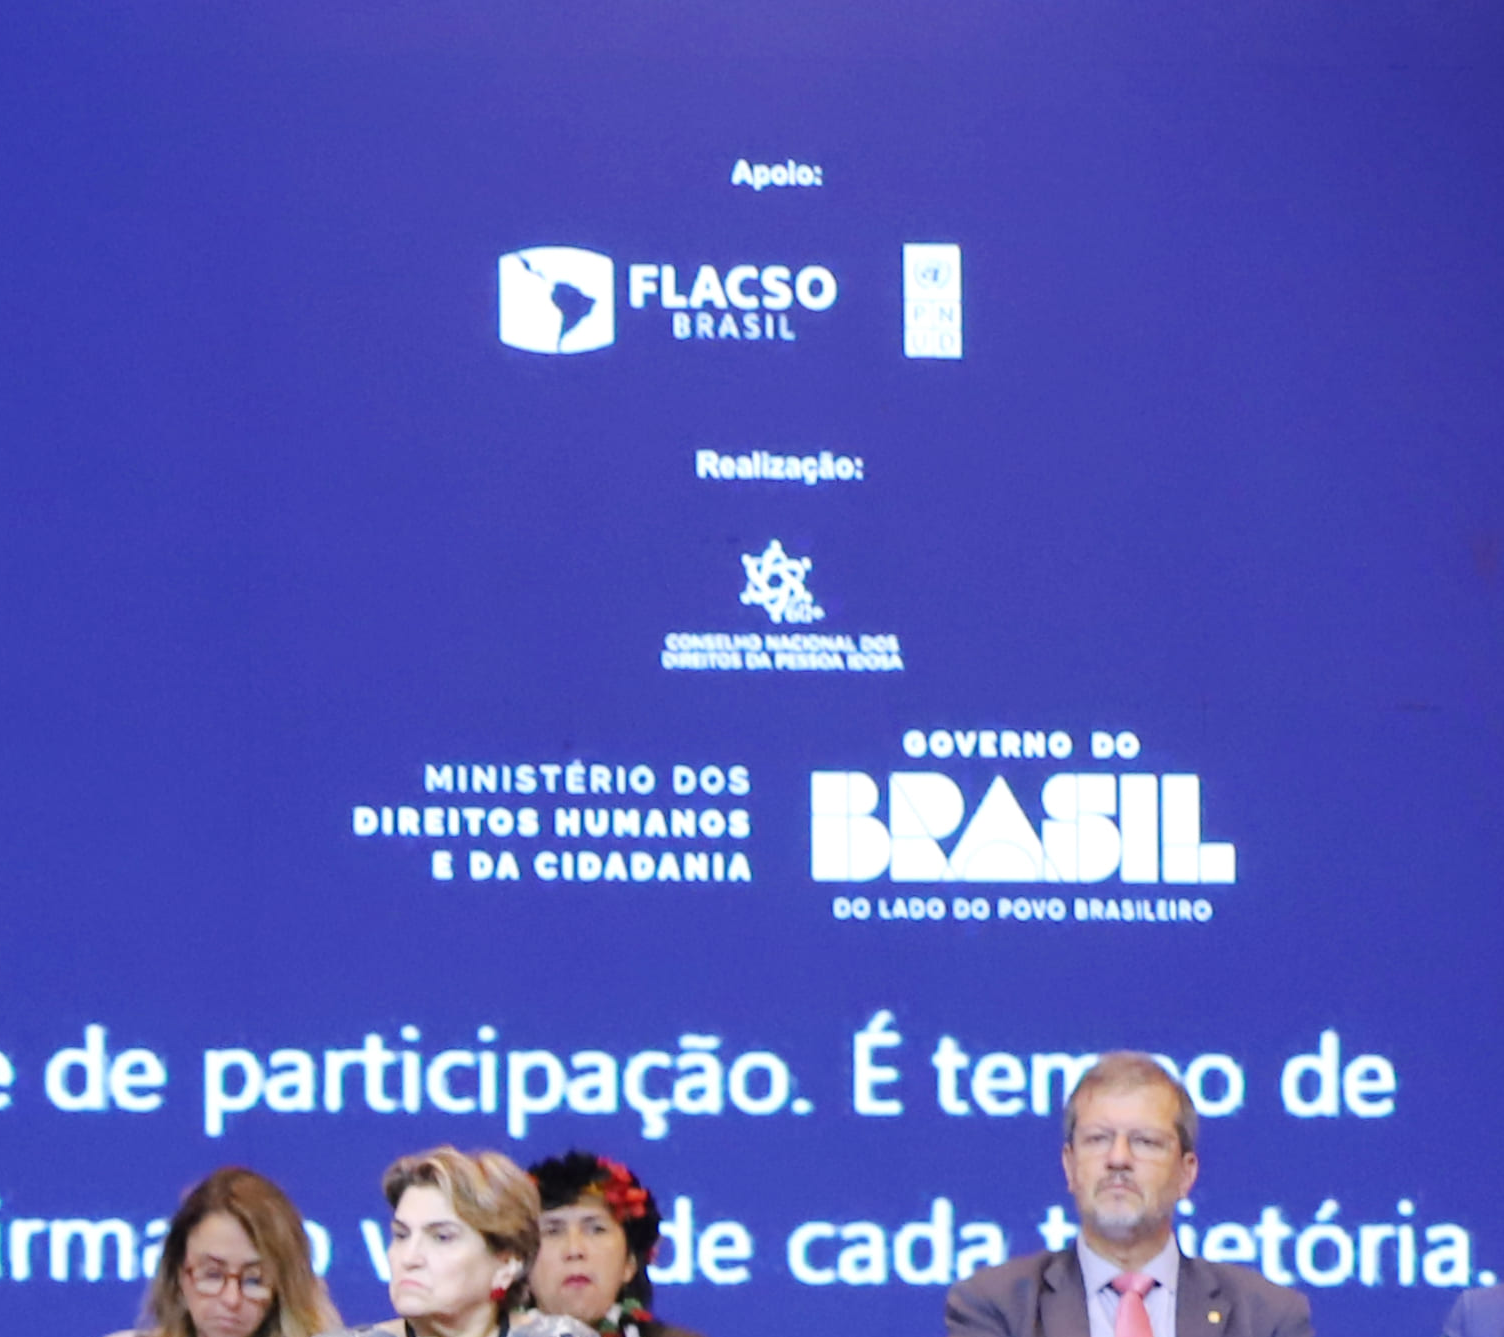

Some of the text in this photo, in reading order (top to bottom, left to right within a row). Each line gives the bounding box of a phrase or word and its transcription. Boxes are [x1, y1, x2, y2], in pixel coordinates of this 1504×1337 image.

[731, 158, 822, 192] Apoio:
[628, 264, 838, 311] FLACSO
[672, 312, 796, 340] BRASIL
[696, 449, 864, 485] Realização:
[664, 633, 900, 652] CONSELHO NACIONAL DOS
[662, 651, 904, 670] DIREITOS DA PESSOA IDOSA
[902, 730, 1141, 759] GOVERNO DO
[425, 758, 750, 795] MINISTÉRIO DOS
[353, 805, 751, 838] DIREITOS HUMANOS
[810, 771, 1237, 884] BRASIL
[432, 850, 751, 881] E DA CIDADANIA
[832, 896, 1214, 922] DO LADO DO POVO BRASILEIRO
[44, 1023, 167, 1112] de
[203, 1024, 812, 1140] participação.
[853, 1009, 903, 1116] É
[1281, 1029, 1398, 1117] de
[787, 1197, 1006, 1285] cada
